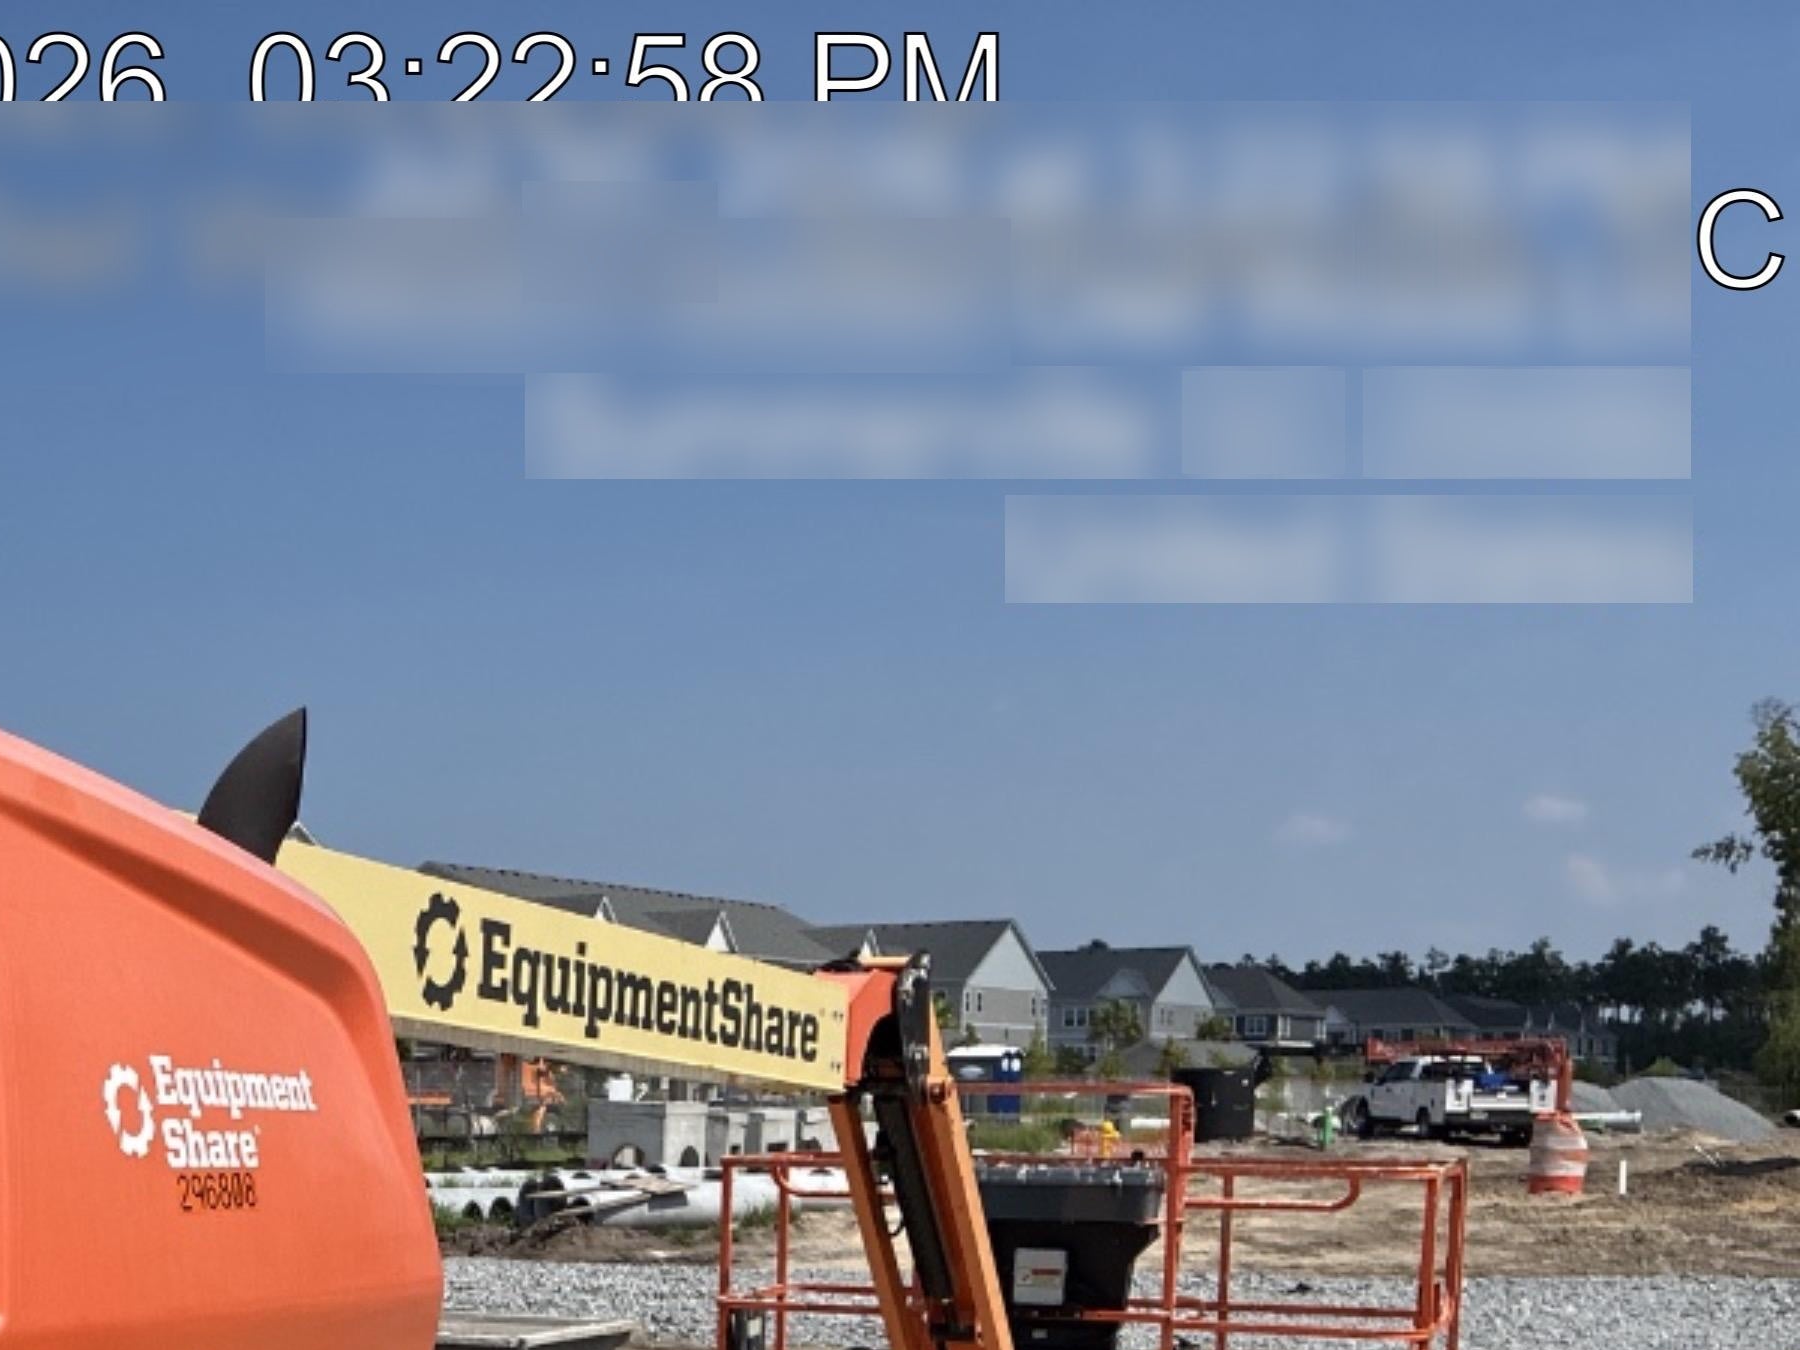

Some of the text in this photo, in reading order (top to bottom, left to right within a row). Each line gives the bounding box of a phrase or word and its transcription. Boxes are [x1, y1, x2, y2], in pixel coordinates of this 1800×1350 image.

[477, 917, 820, 1062] EquipmentShare
[149, 1055, 318, 1119] Equipment
[162, 1118, 260, 1168] Share
[177, 1172, 258, 1212] 296808
